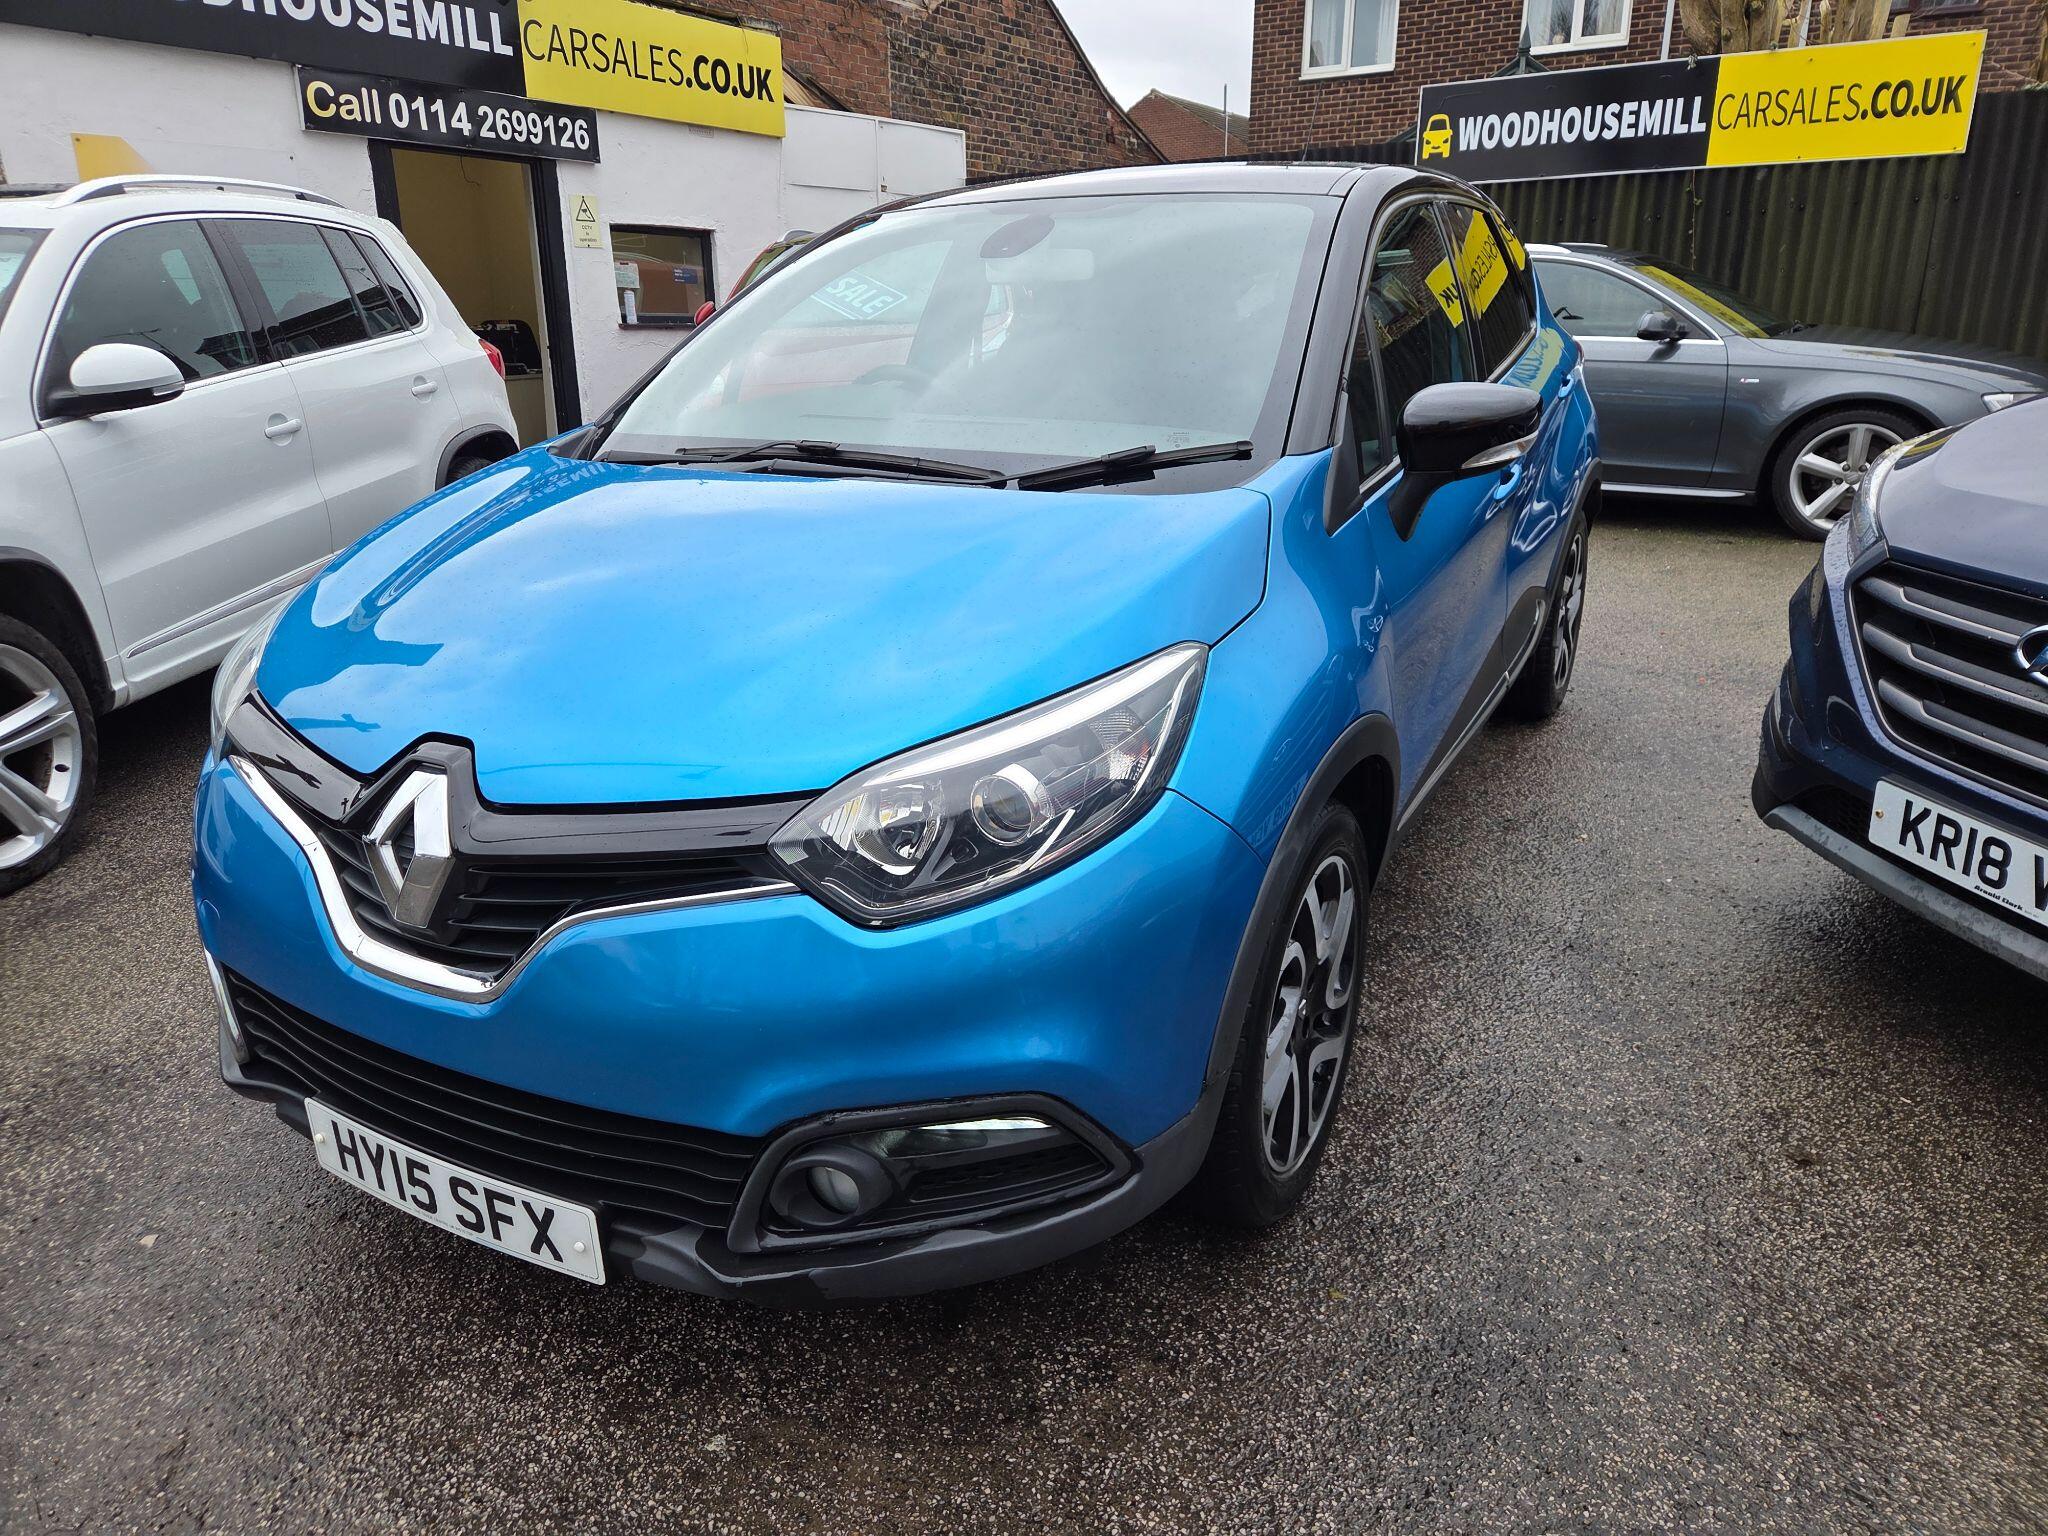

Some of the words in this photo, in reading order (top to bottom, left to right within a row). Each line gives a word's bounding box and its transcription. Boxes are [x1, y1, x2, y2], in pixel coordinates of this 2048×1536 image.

[523, 19, 775, 103] CARSALES.CO.UK
[306, 80, 382, 124] Call
[388, 92, 473, 136] 0114
[477, 105, 590, 150] 2699126
[1459, 95, 1707, 151] WOODHOUSEMILL
[1718, 75, 1968, 130] CARSALES.CO.UK
[825, 277, 894, 313] SALE
[1899, 799, 2012, 890] KR18
[331, 1119, 438, 1215] HY15
[449, 1175, 563, 1263] SFX
